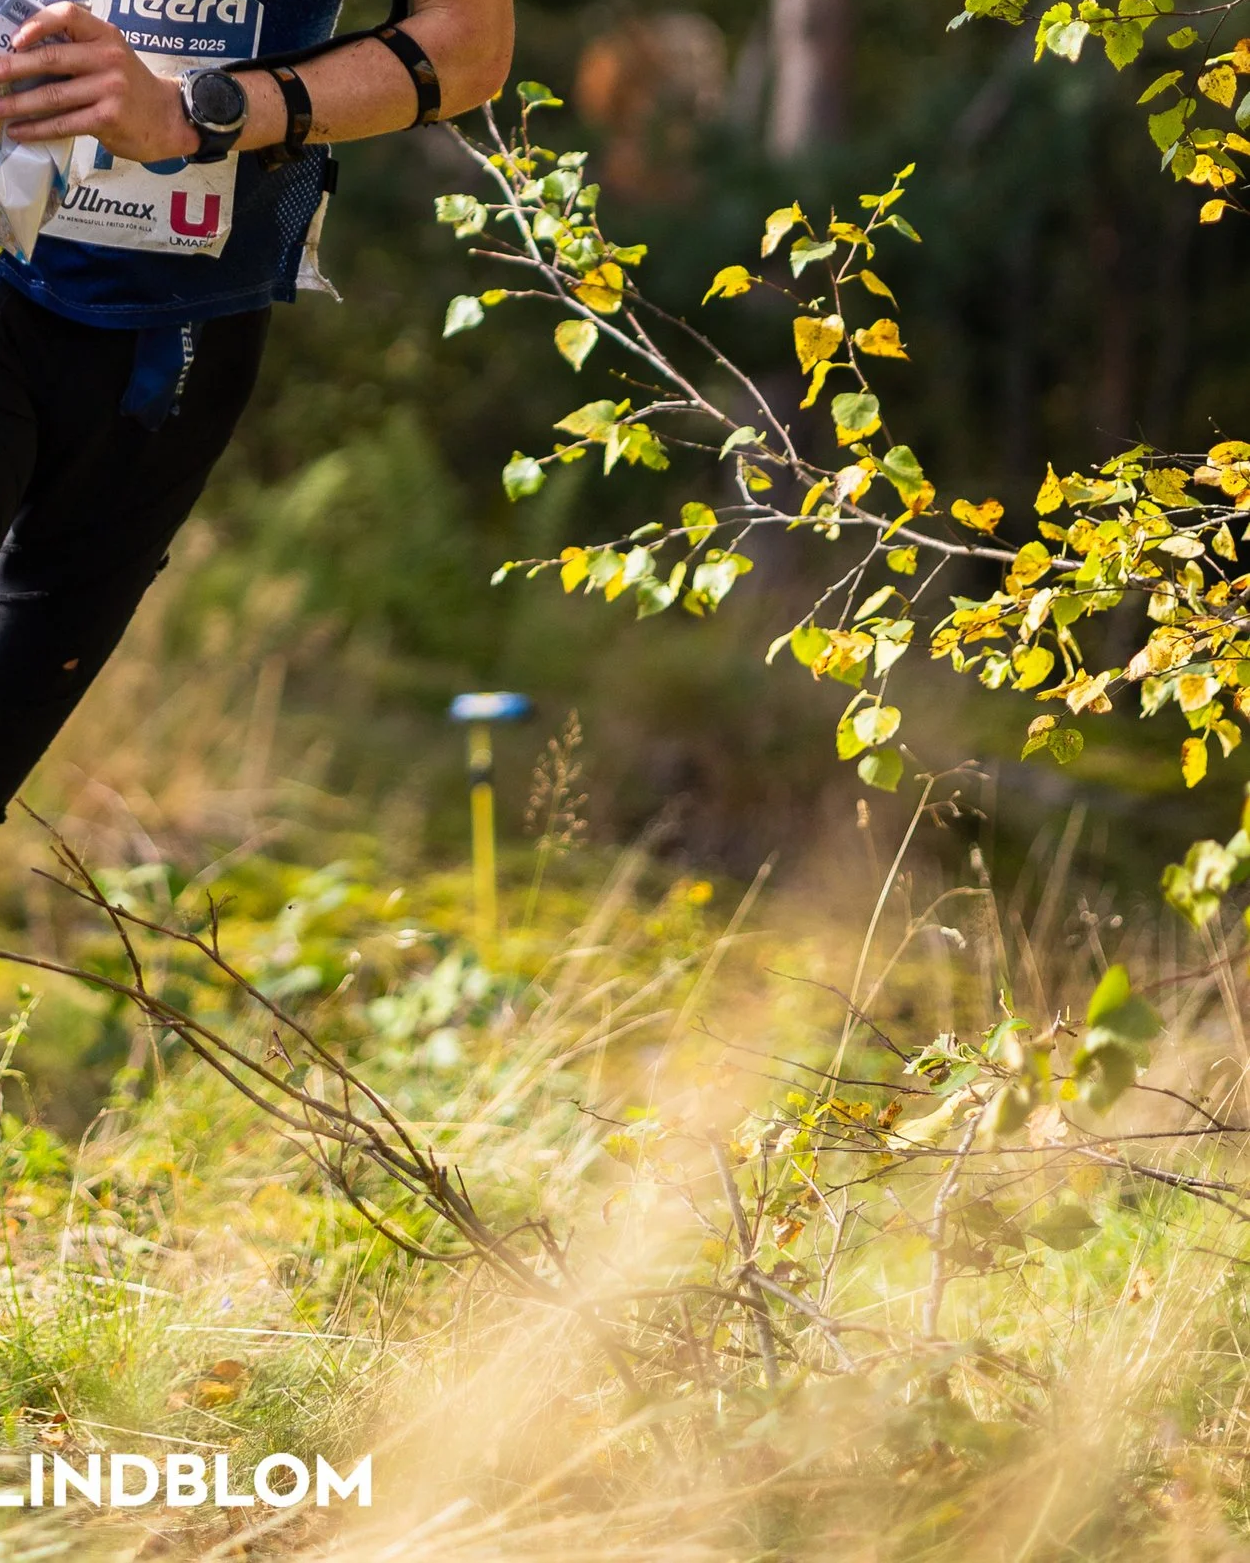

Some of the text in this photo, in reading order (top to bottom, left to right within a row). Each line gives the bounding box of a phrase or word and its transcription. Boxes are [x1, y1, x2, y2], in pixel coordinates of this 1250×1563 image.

[188, 38, 226, 52] 2025
[61, 184, 155, 221] Ullmax
[170, 191, 221, 237] U
